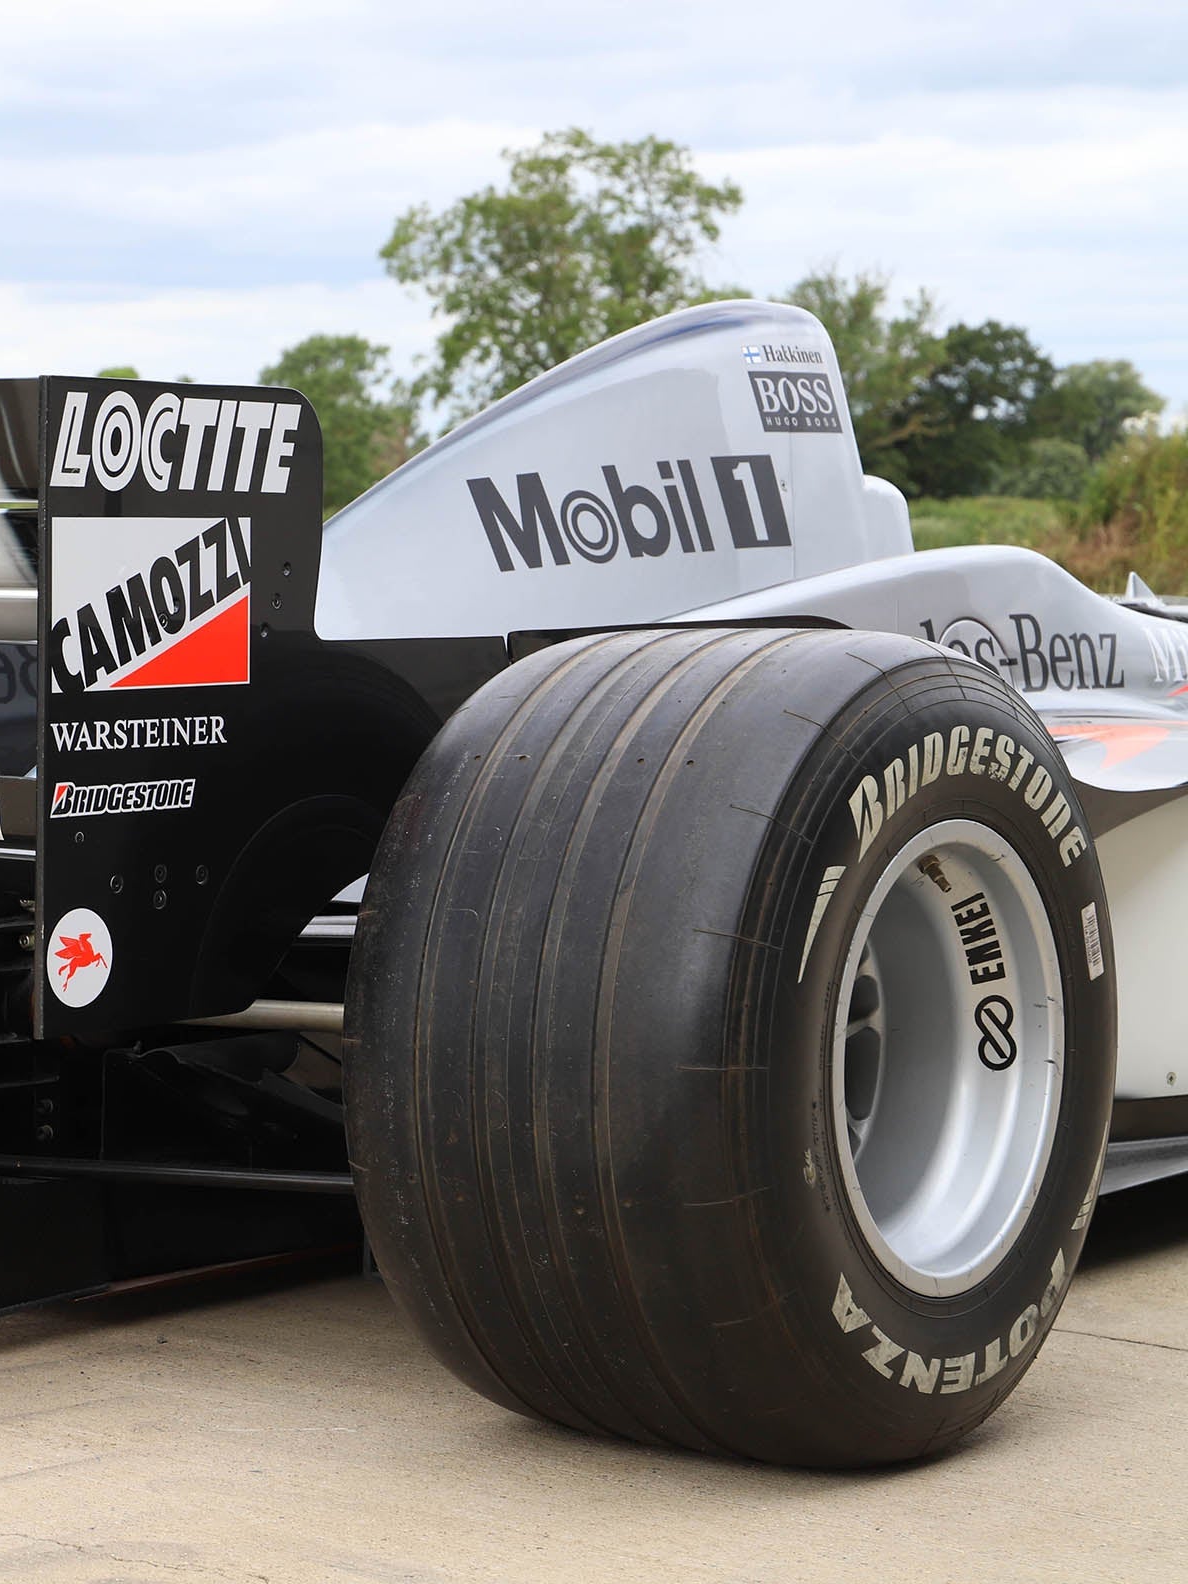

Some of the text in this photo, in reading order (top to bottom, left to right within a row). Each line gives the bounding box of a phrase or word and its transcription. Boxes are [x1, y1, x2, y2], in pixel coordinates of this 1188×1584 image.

[49, 390, 302, 494] LOCTITE
[754, 377, 833, 414] BOSS
[765, 416, 838, 427] HUGO BOSS
[466, 458, 715, 572] Mobil
[50, 517, 252, 694] CAMOZZI
[50, 715, 228, 752] WARSTEINER
[49, 778, 196, 819] BRIDGESTONE
[847, 725, 1088, 868] BRIDGESTONE
[950, 892, 1006, 985] ENKEI
[831, 1247, 1065, 1394] POTENZA
